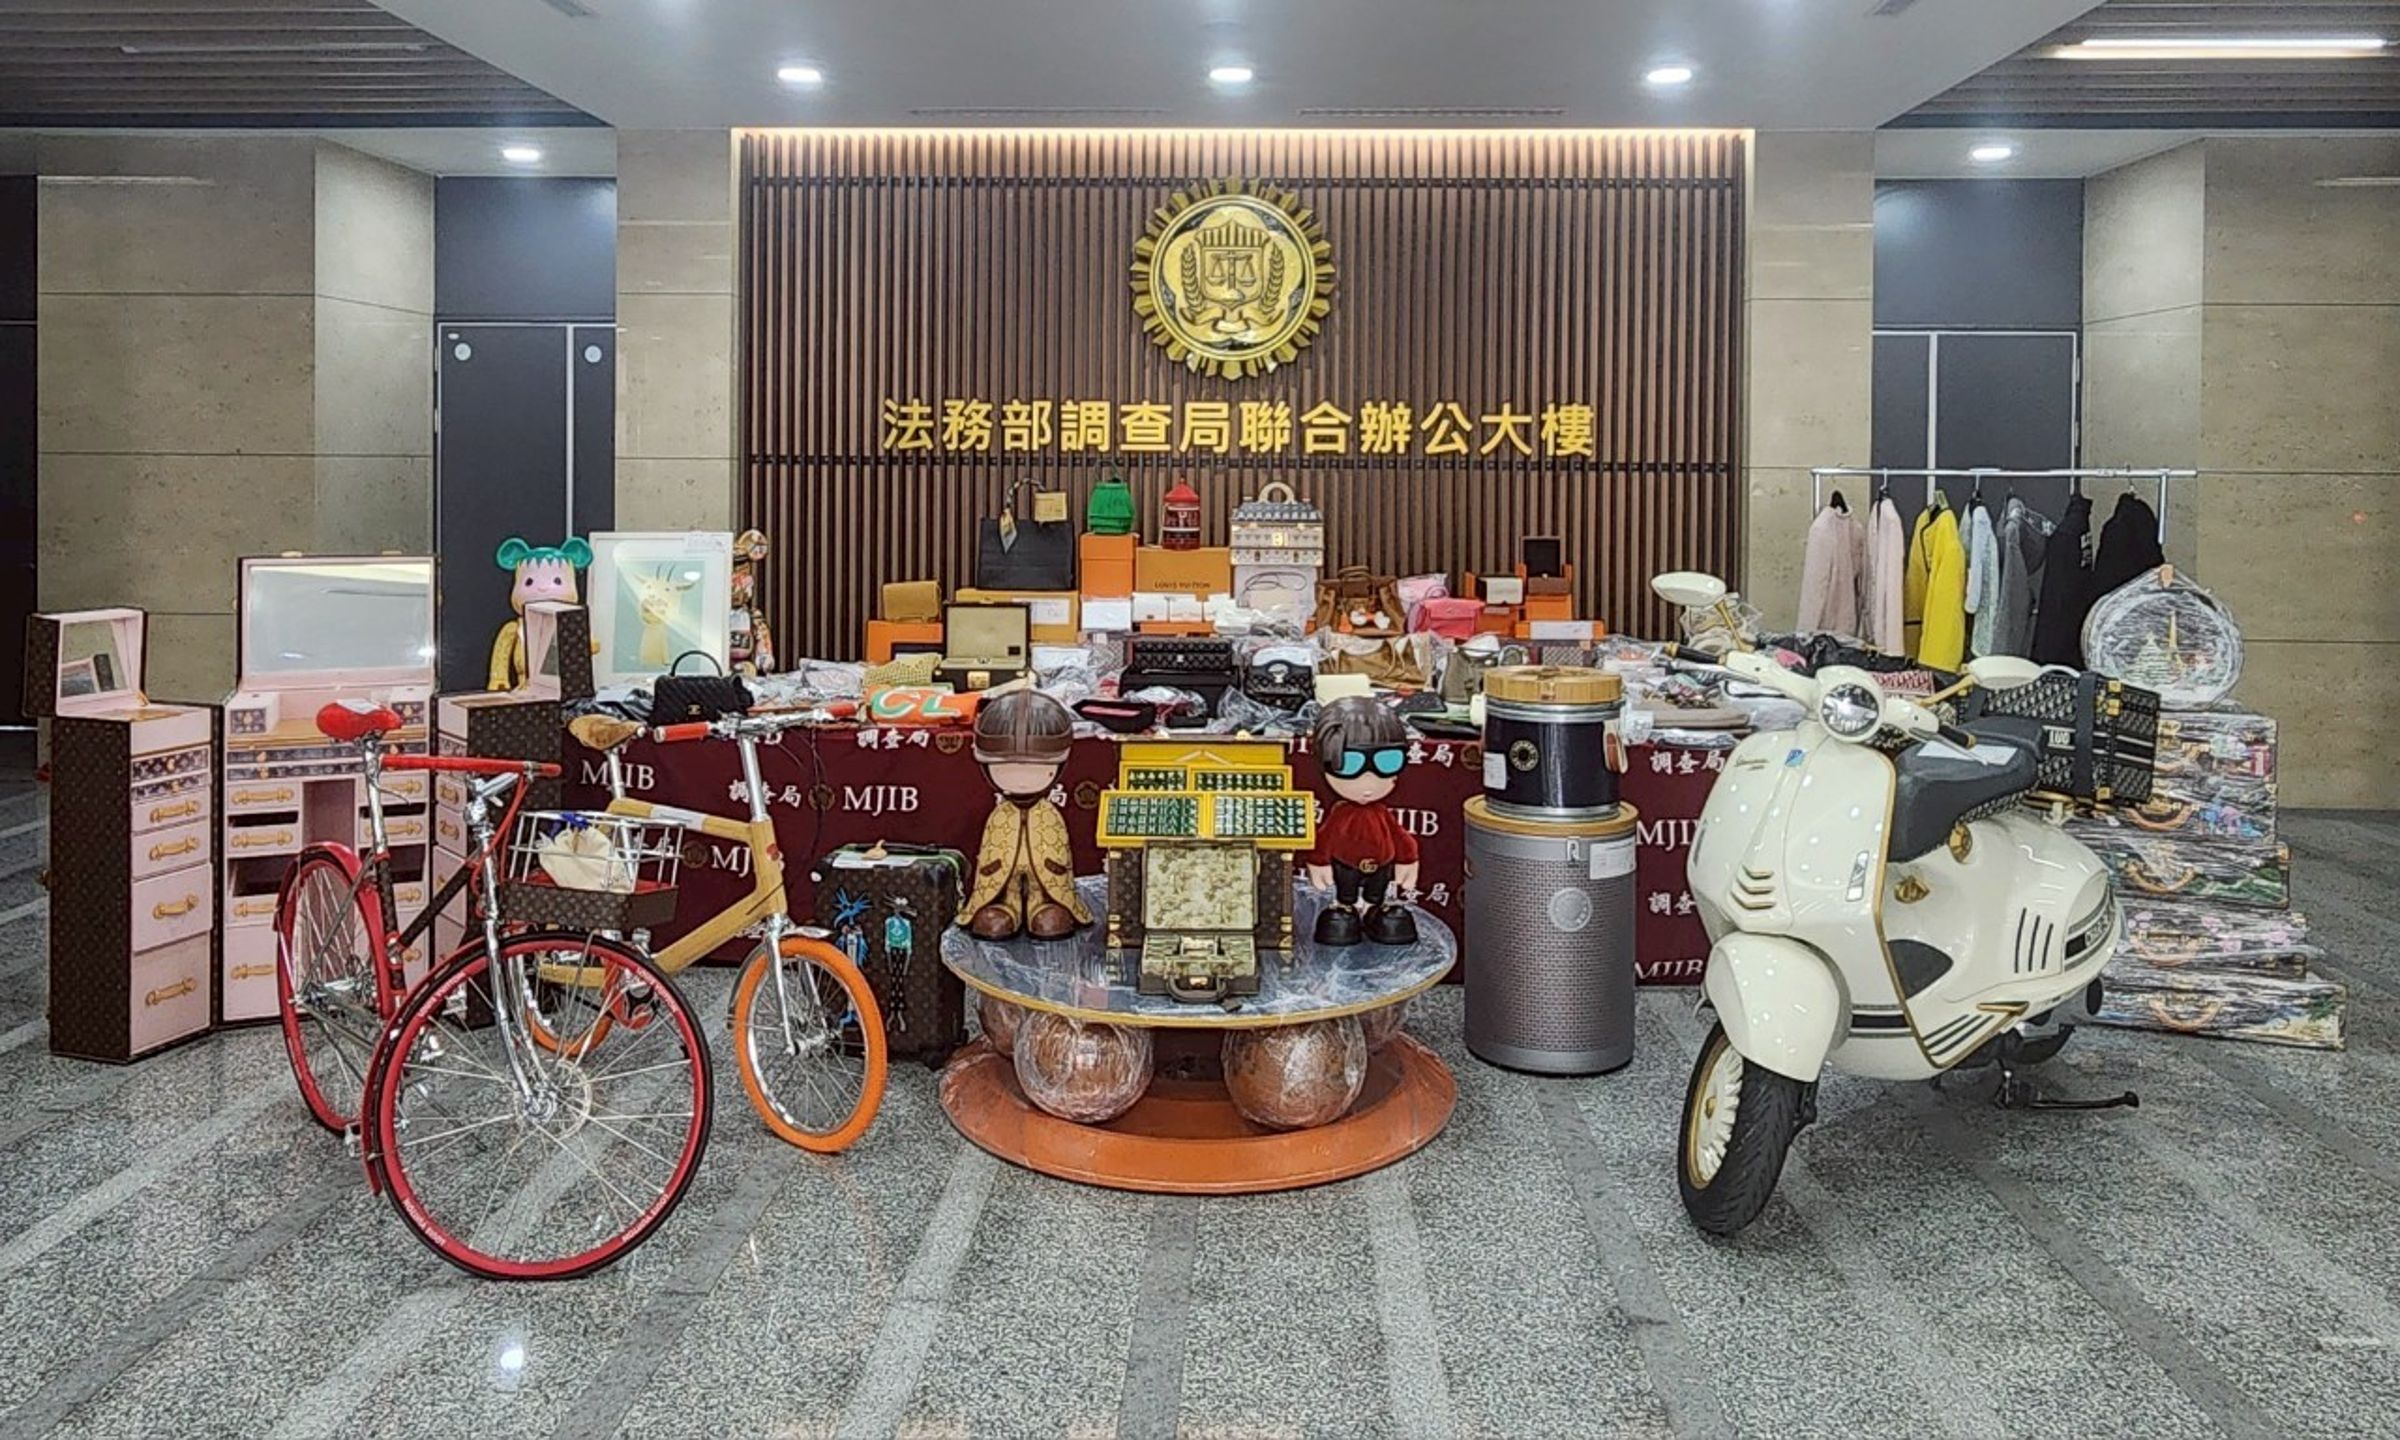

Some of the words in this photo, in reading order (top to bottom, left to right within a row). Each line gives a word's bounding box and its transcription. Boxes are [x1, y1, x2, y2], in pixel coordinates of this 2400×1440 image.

[882, 400, 1597, 457] 法務部調查局聯合辦公大樓
[856, 727, 930, 749] 調查局
[1406, 741, 1455, 768] 查局
[1649, 750, 1725, 775] 調查局
[842, 786, 919, 816] MJIB
[1636, 819, 1699, 851] MJI
[1648, 890, 1697, 916] 調查
